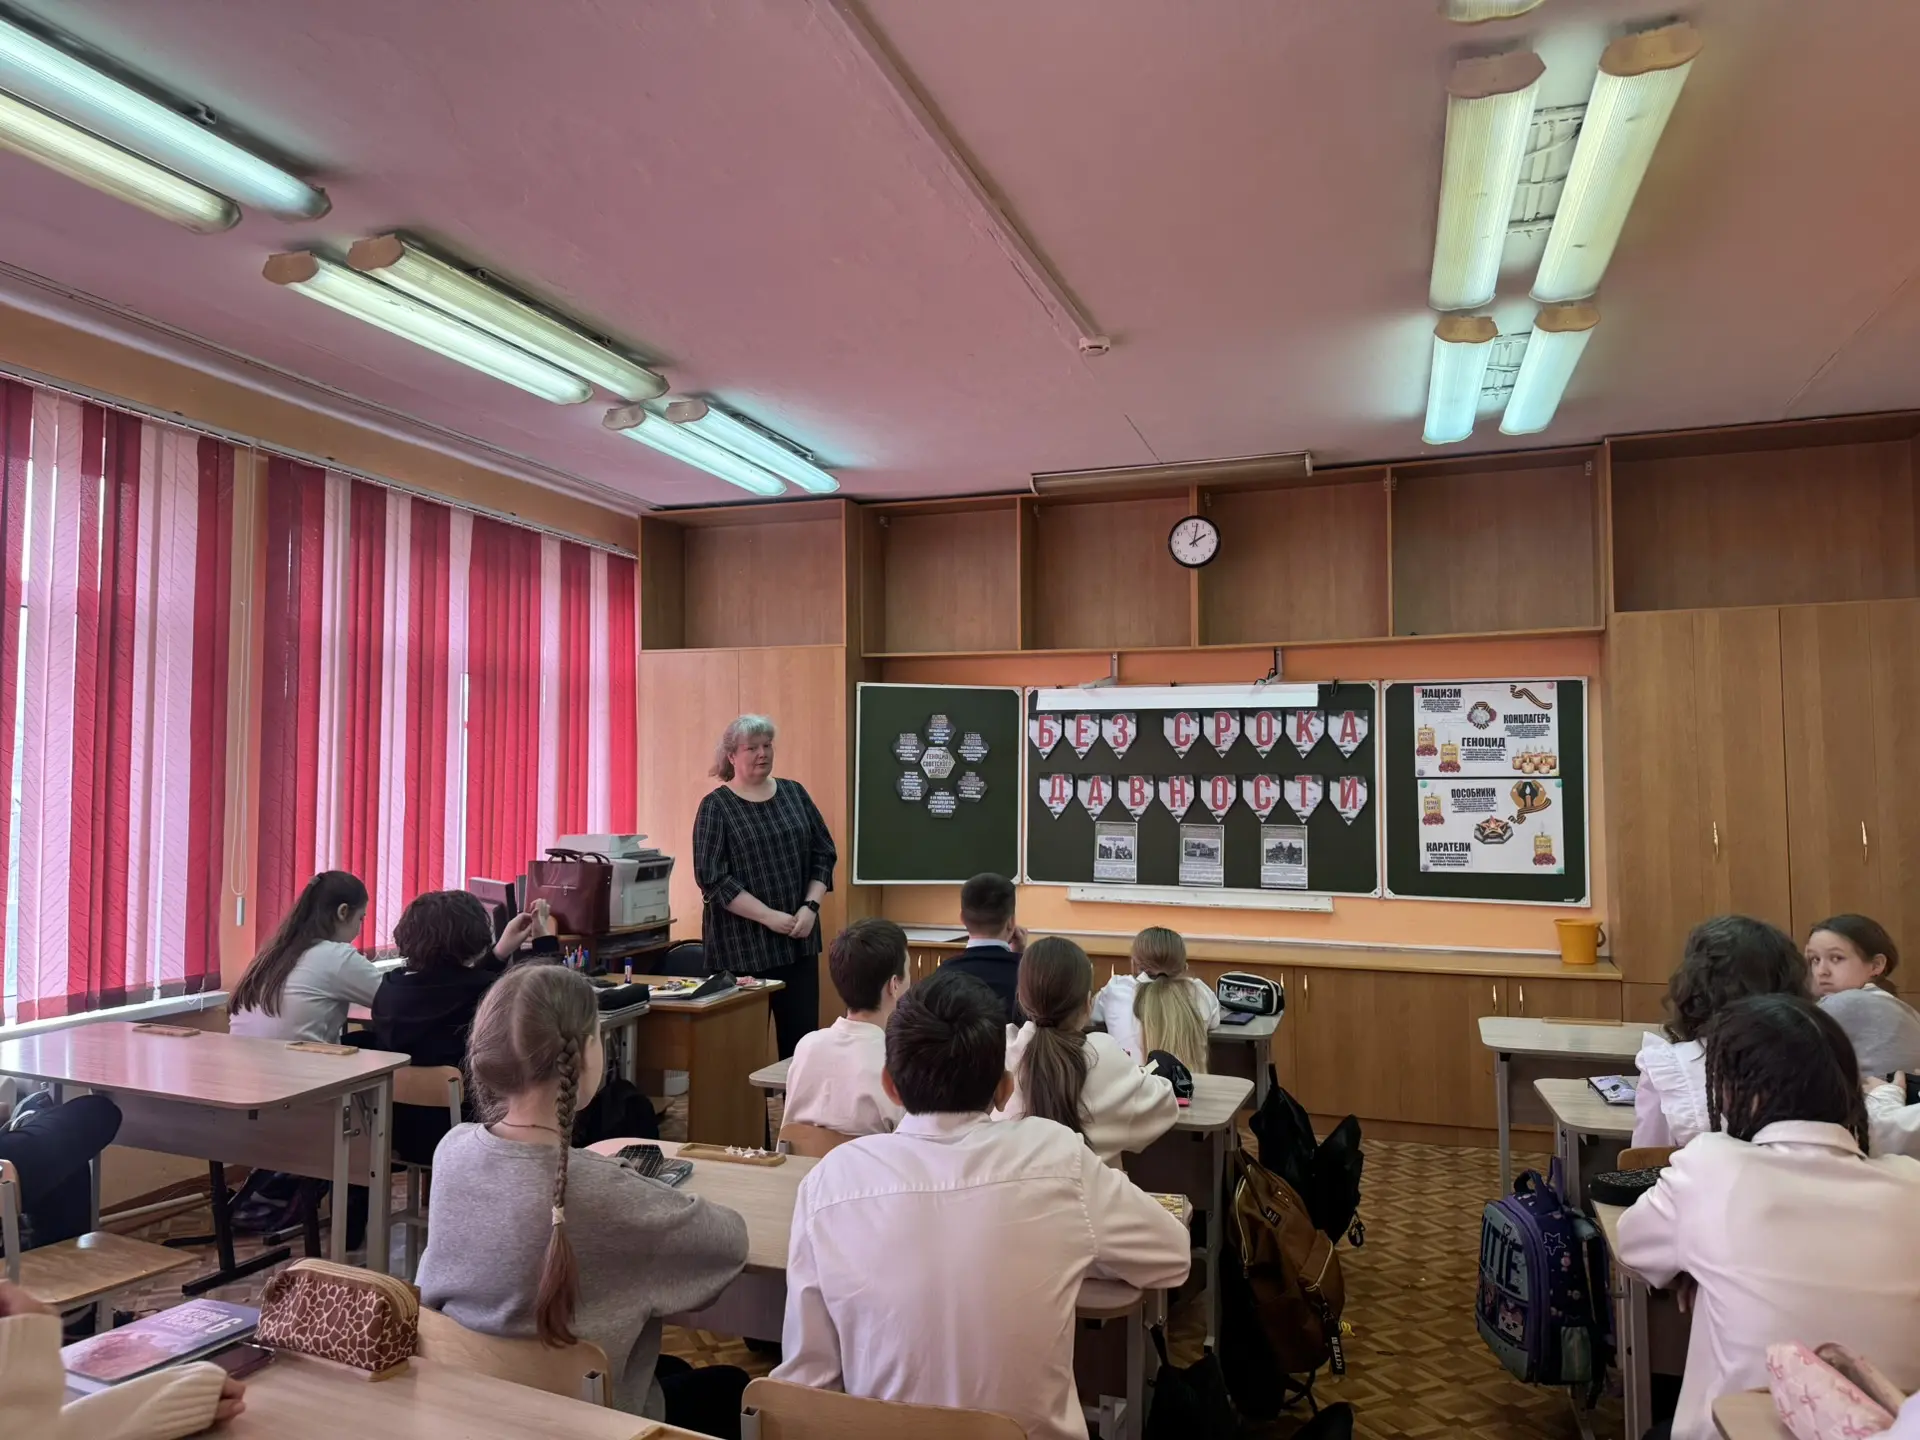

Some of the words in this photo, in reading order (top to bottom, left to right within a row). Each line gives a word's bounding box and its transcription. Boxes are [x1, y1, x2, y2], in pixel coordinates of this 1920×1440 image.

[1421, 688, 1462, 700] НАЦИЗМ
[1503, 713, 1551, 725] КОНЦЛАГЕРЬ
[1038, 714, 1128, 748] БЕЗ
[1174, 710, 1358, 747] СРОКА
[1461, 737, 1506, 748] ГЕНОЦИД
[1049, 774, 1358, 811] ДАВНОСТИ
[1450, 787, 1497, 799] ПОСОБНИКИ
[1426, 842, 1471, 852] КАРАТЕЛИ
[205, 1317, 243, 1333] 6
